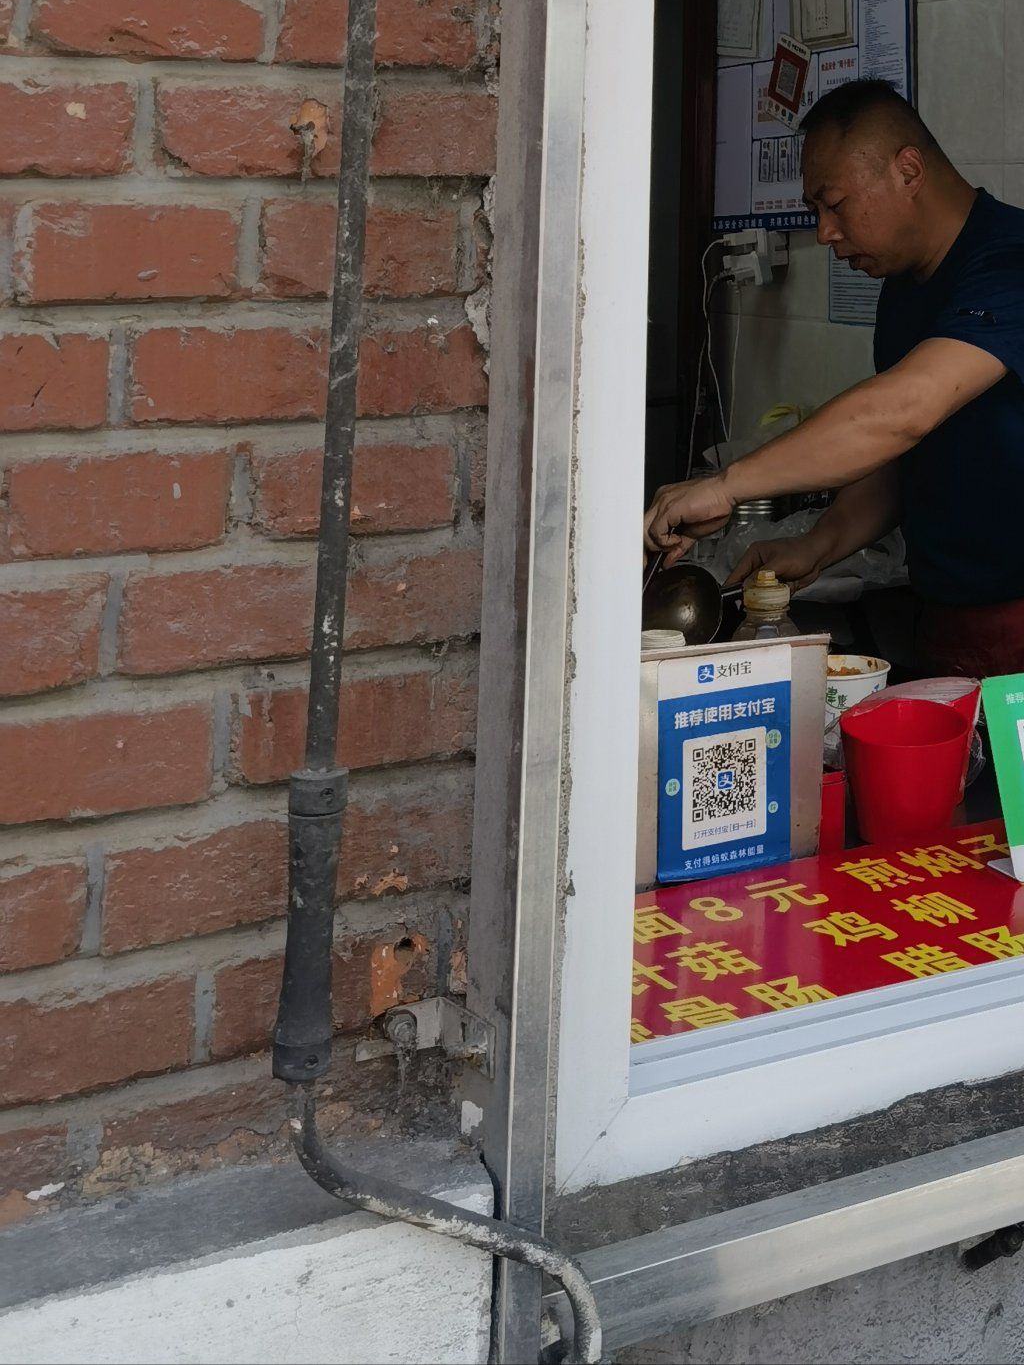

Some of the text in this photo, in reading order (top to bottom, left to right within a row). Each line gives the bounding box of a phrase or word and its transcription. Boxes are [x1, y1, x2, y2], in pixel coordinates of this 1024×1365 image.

[716, 660, 752, 678] 支付宝
[674, 697, 776, 730] 推荐使用支付宝
